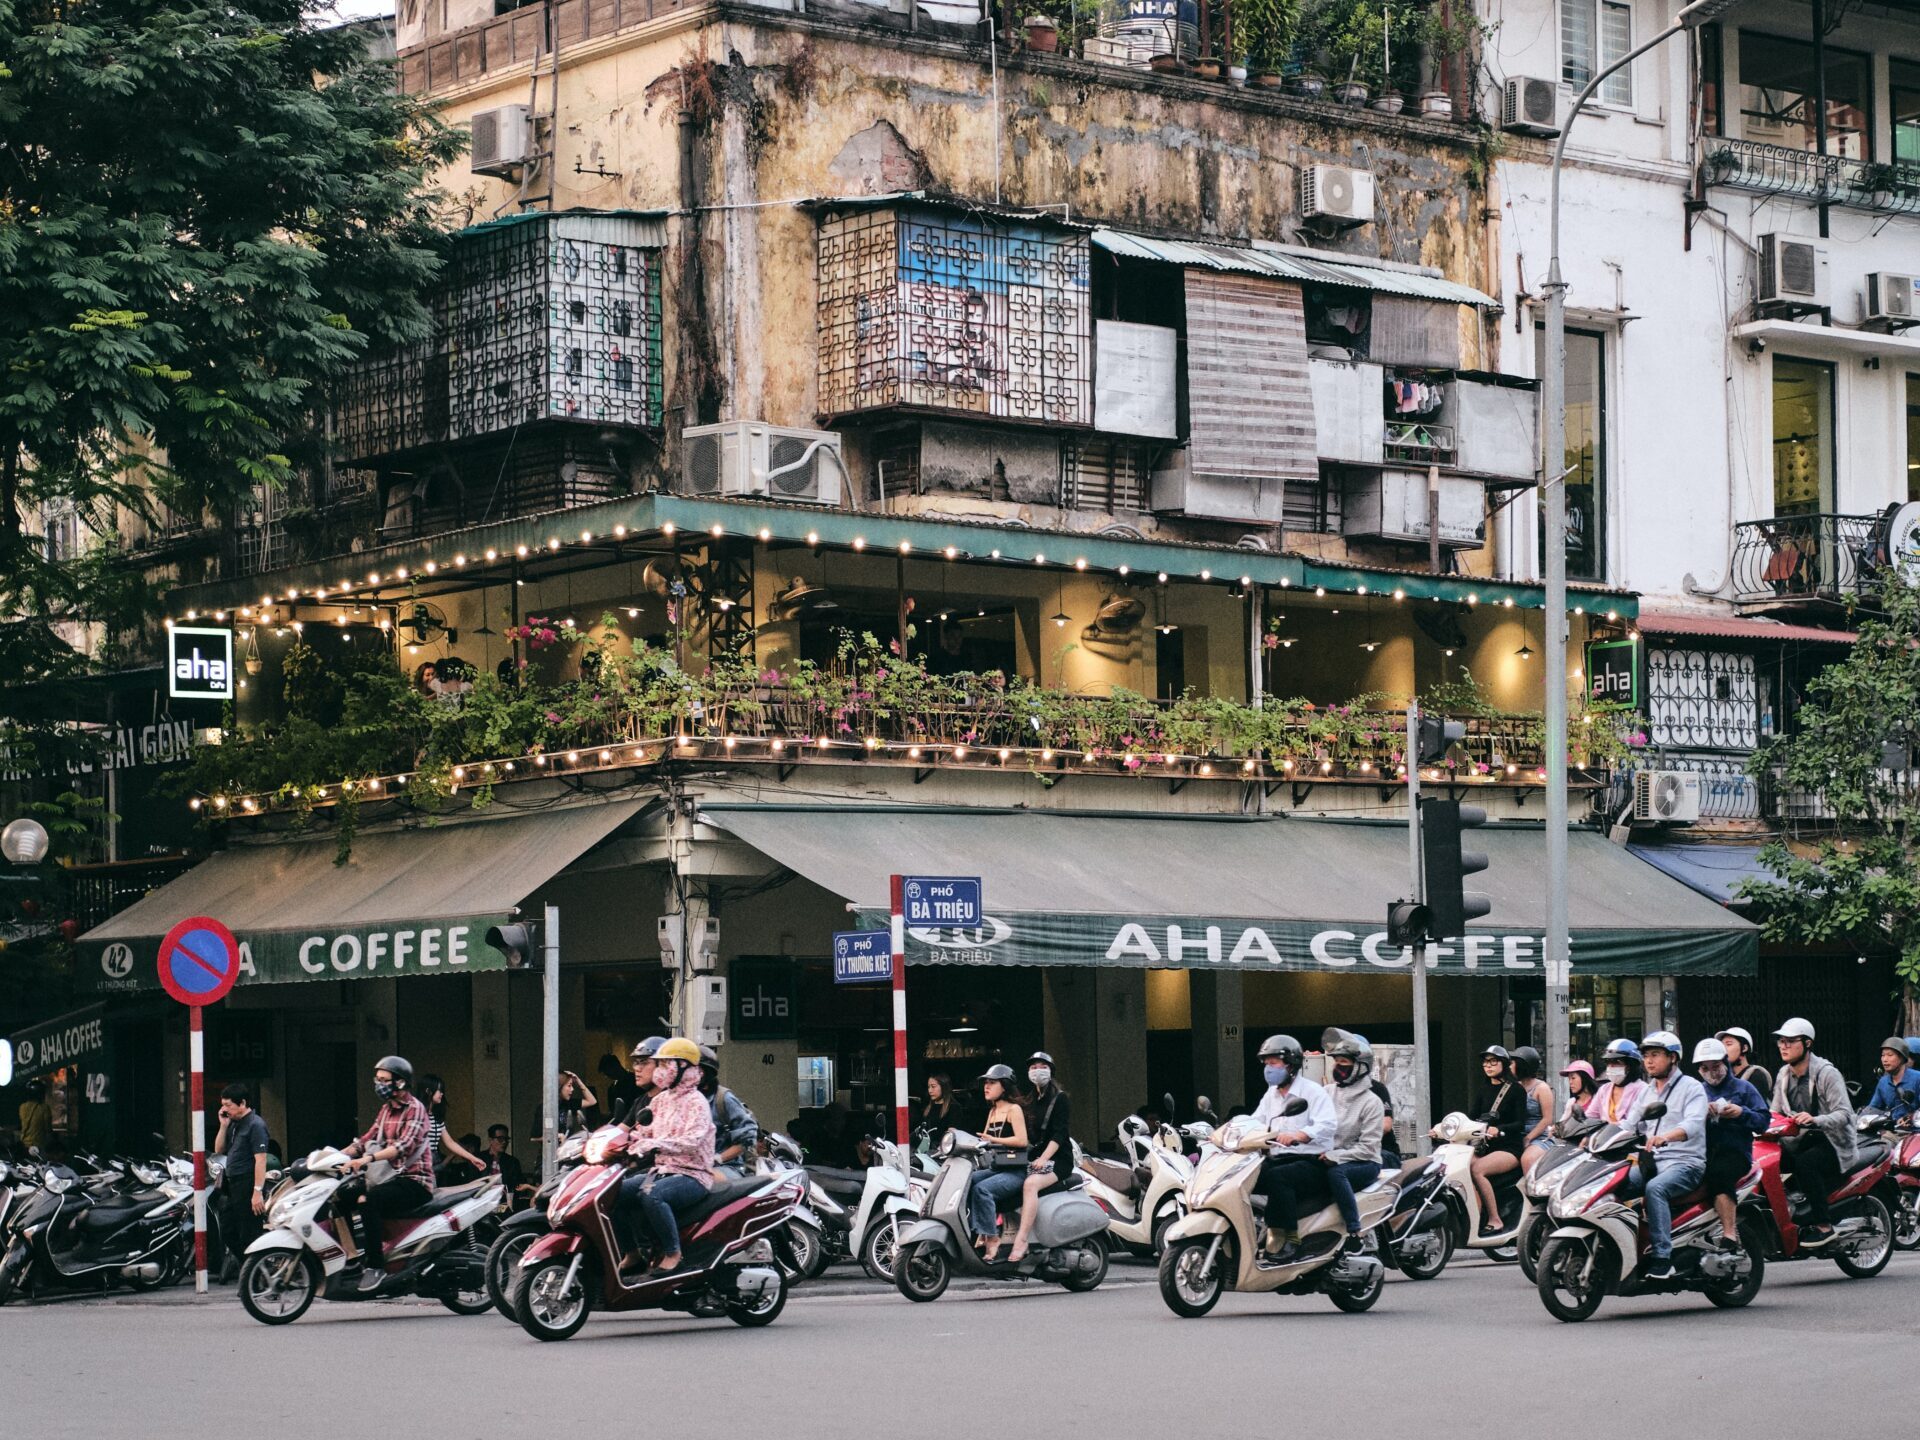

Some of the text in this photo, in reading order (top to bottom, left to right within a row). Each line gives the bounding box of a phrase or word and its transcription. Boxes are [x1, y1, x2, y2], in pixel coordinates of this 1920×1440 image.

[177, 647, 226, 680] aha
[1593, 662, 1631, 692] aha
[931, 883, 954, 897] PHỐ
[911, 898, 974, 922] BÀ TRIỆU
[299, 926, 470, 975] COFFEE
[854, 935, 872, 951] PHỐ
[1105, 923, 1283, 965] AHA
[109, 946, 126, 974] 42
[838, 954, 846, 975] LÝ
[875, 952, 890, 975] KIỆT
[741, 983, 789, 1017] aha
[40, 1019, 103, 1067] AHA COFFEE
[762, 1054, 775, 1065] 40
[86, 1073, 107, 1103] 42
